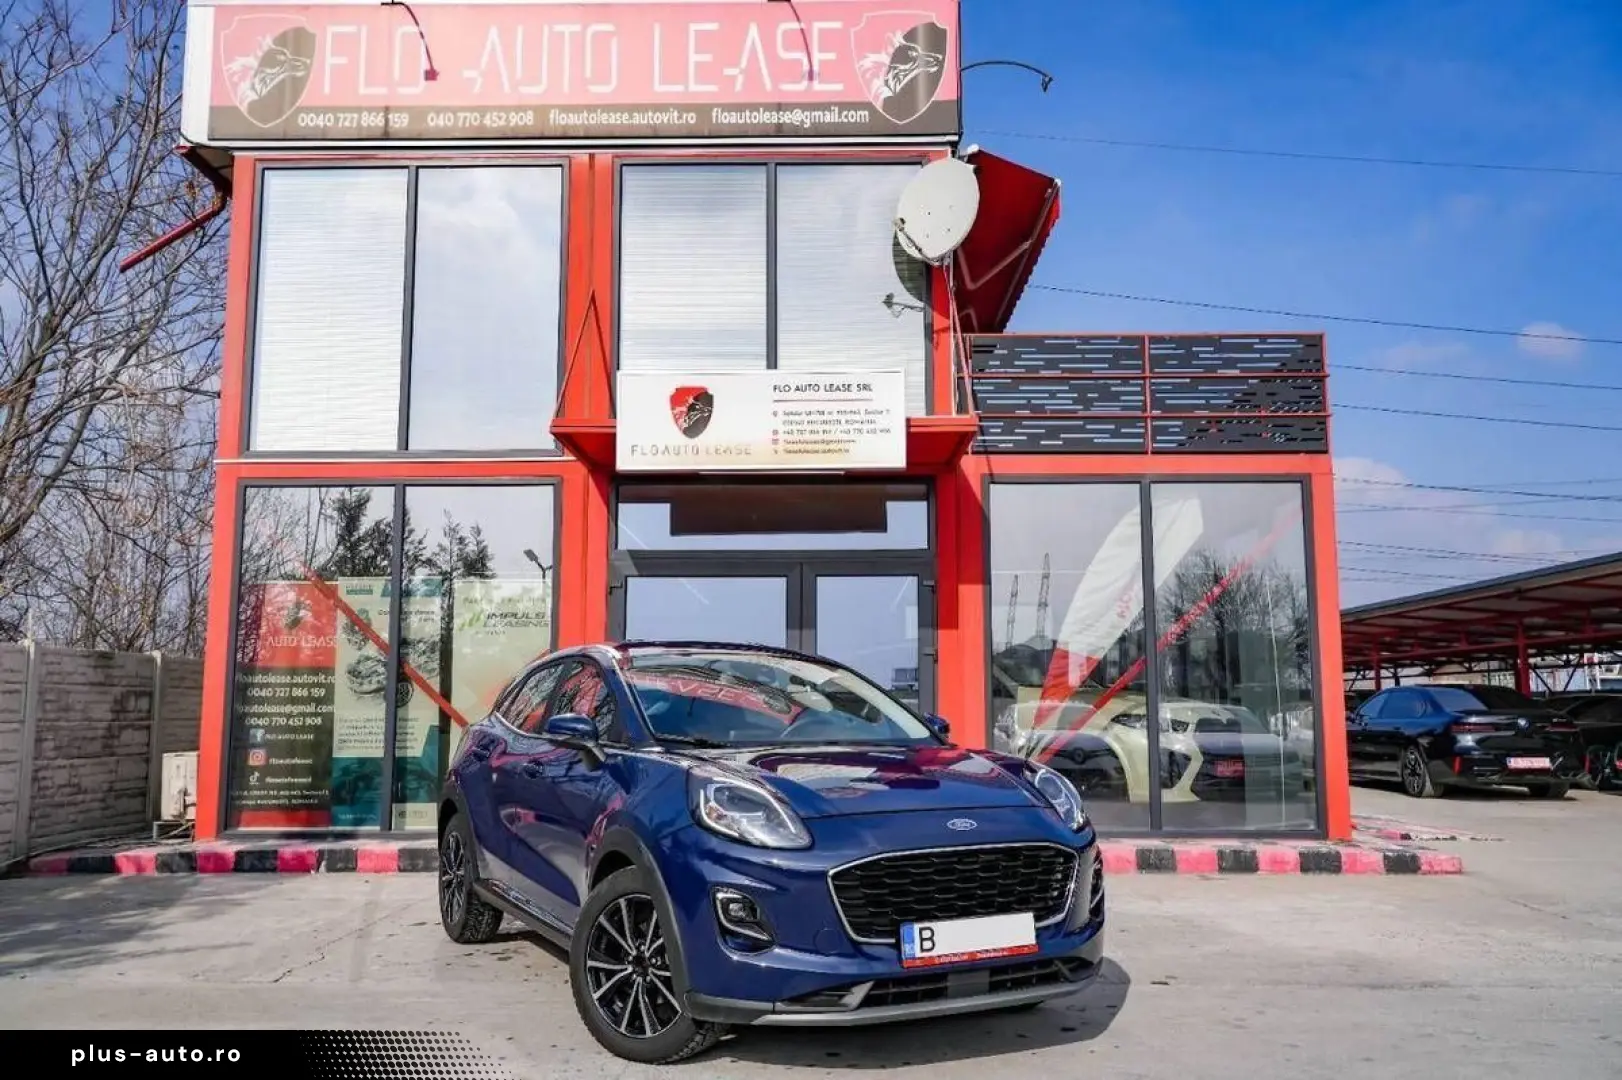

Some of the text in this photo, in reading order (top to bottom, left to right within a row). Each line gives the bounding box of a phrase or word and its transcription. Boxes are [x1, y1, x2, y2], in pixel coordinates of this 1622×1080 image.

[323, 21, 844, 95] FLO AUTO LEASE
[298, 112, 409, 127] 0040 727 866 159
[427, 111, 534, 126] 040 770 452 908
[549, 108, 697, 125] floautolease.autovit.ro
[711, 106, 869, 127] floautolease@gmail.com
[773, 383, 873, 393] FLO AUTO LEASE SRL
[705, 443, 752, 455] LEASE
[487, 611, 545, 620] IMPULS
[918, 926, 935, 953] B
